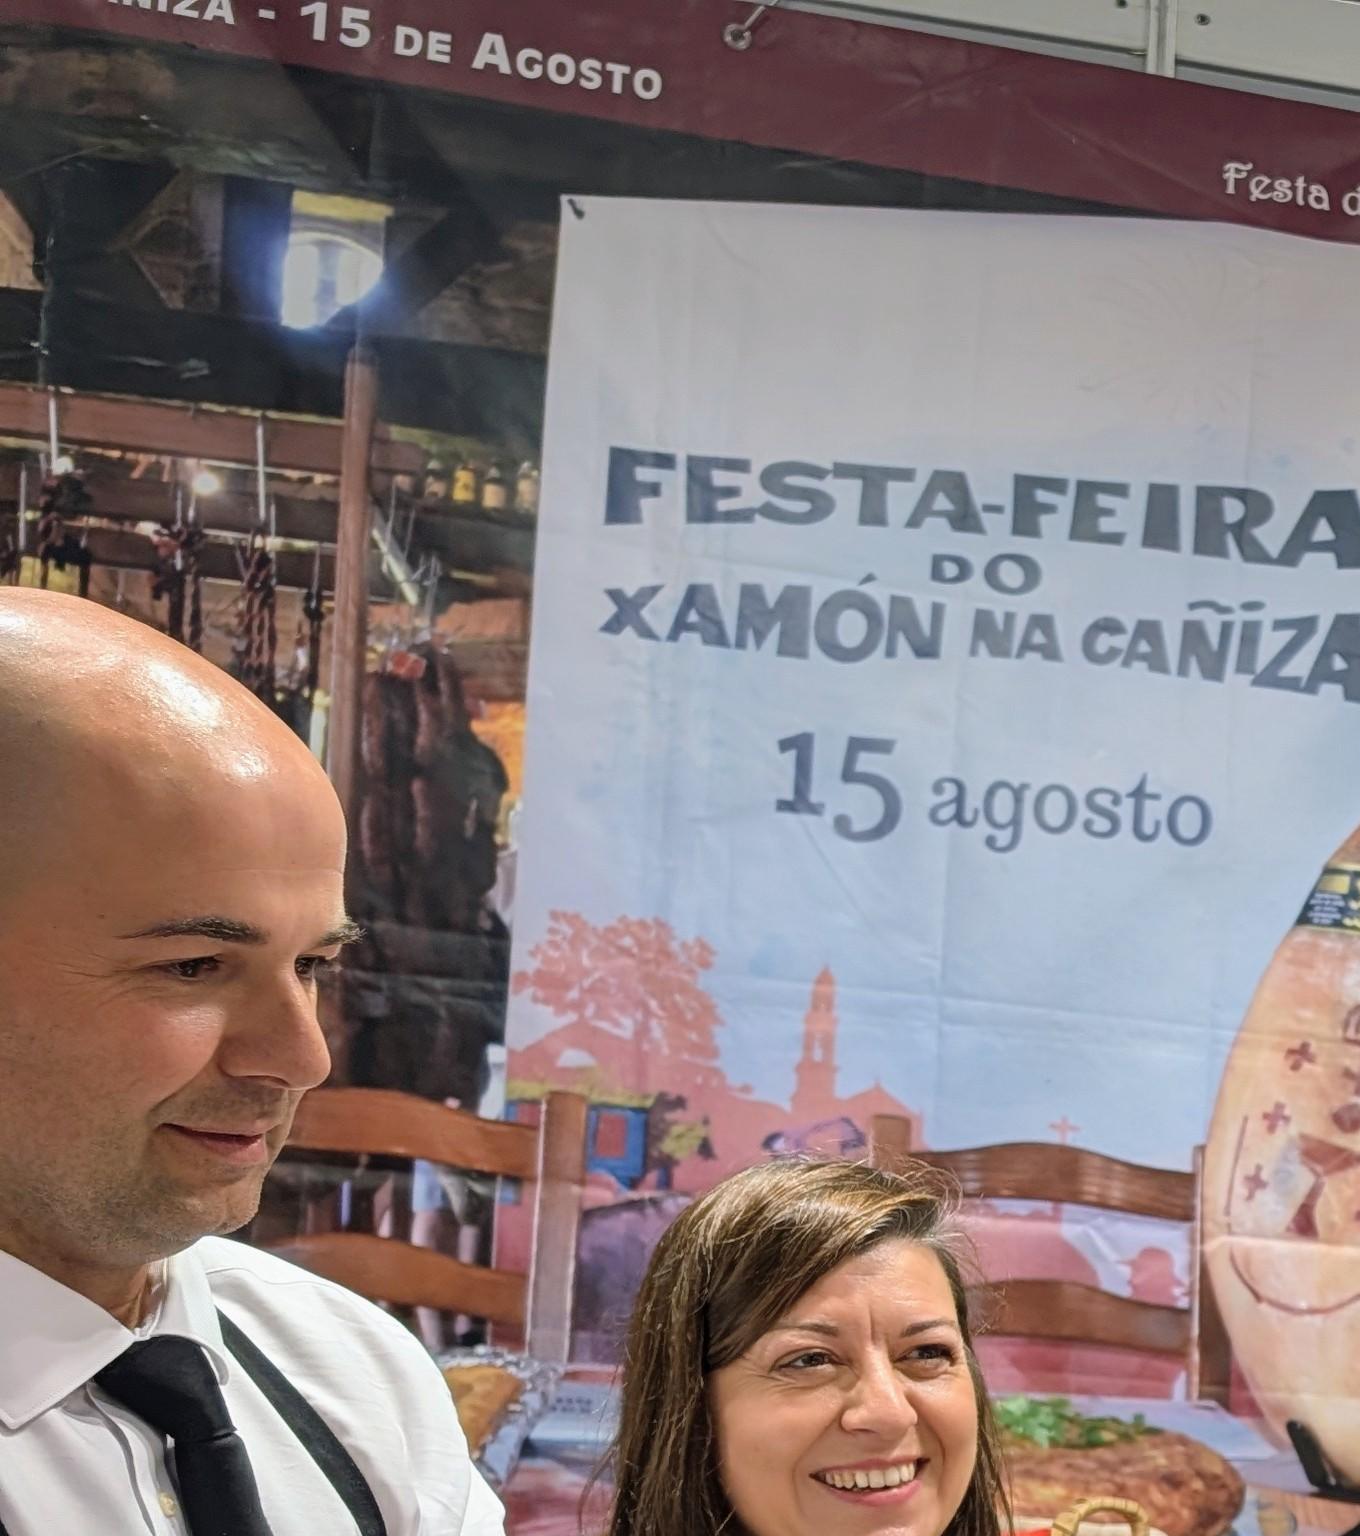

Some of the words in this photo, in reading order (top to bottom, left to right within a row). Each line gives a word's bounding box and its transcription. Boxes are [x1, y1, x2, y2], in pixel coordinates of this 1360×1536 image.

[301, 1, 371, 47] 15
[1222, 162, 1330, 212] Festa
[930, 554, 1042, 594] DO
[600, 573, 946, 663] XAMÓN
[969, 608, 1063, 663] NA
[775, 731, 903, 841] 15
[927, 772, 1212, 852] agosto
